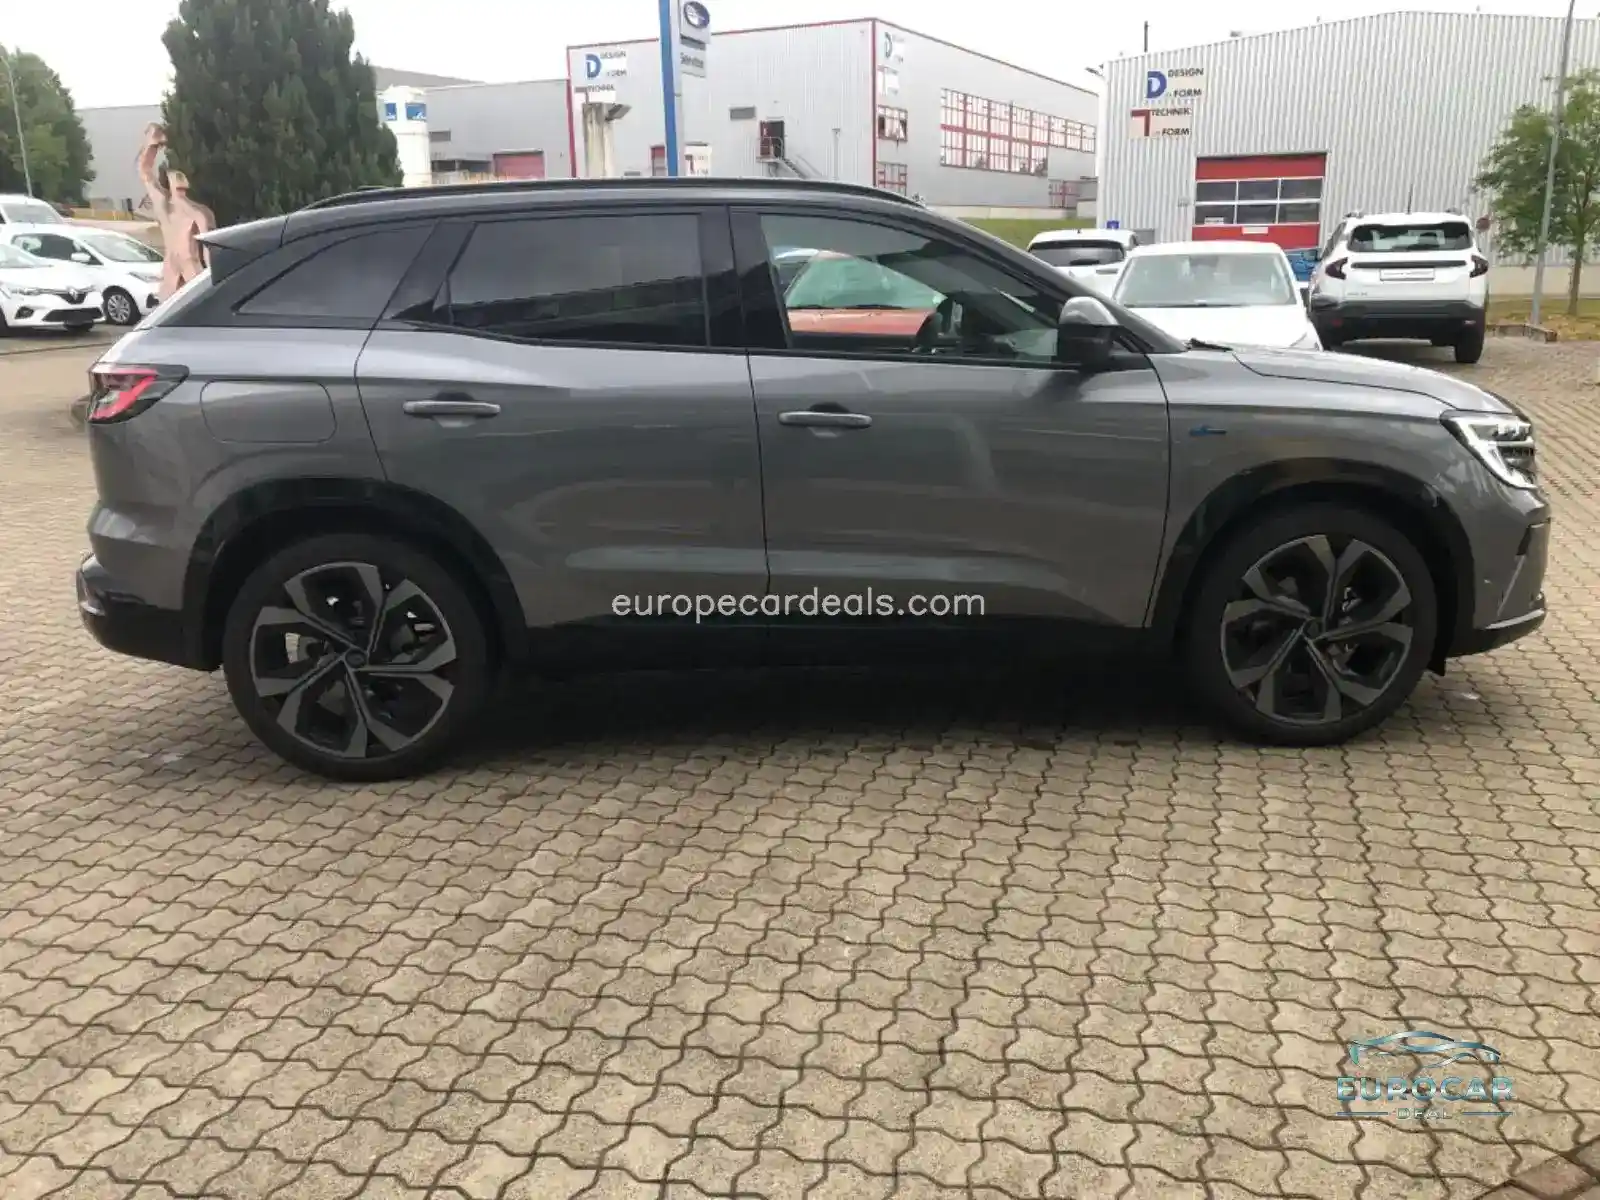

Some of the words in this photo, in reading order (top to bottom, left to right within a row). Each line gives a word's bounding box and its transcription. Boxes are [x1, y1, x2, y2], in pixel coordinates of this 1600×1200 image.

[585, 53, 602, 78] D
[1168, 67, 1204, 77] DESIGN
[1146, 70, 1167, 98] D
[1174, 88, 1202, 97] FORM
[1152, 107, 1191, 116] TECHNIK
[1162, 127, 1190, 136] FORM
